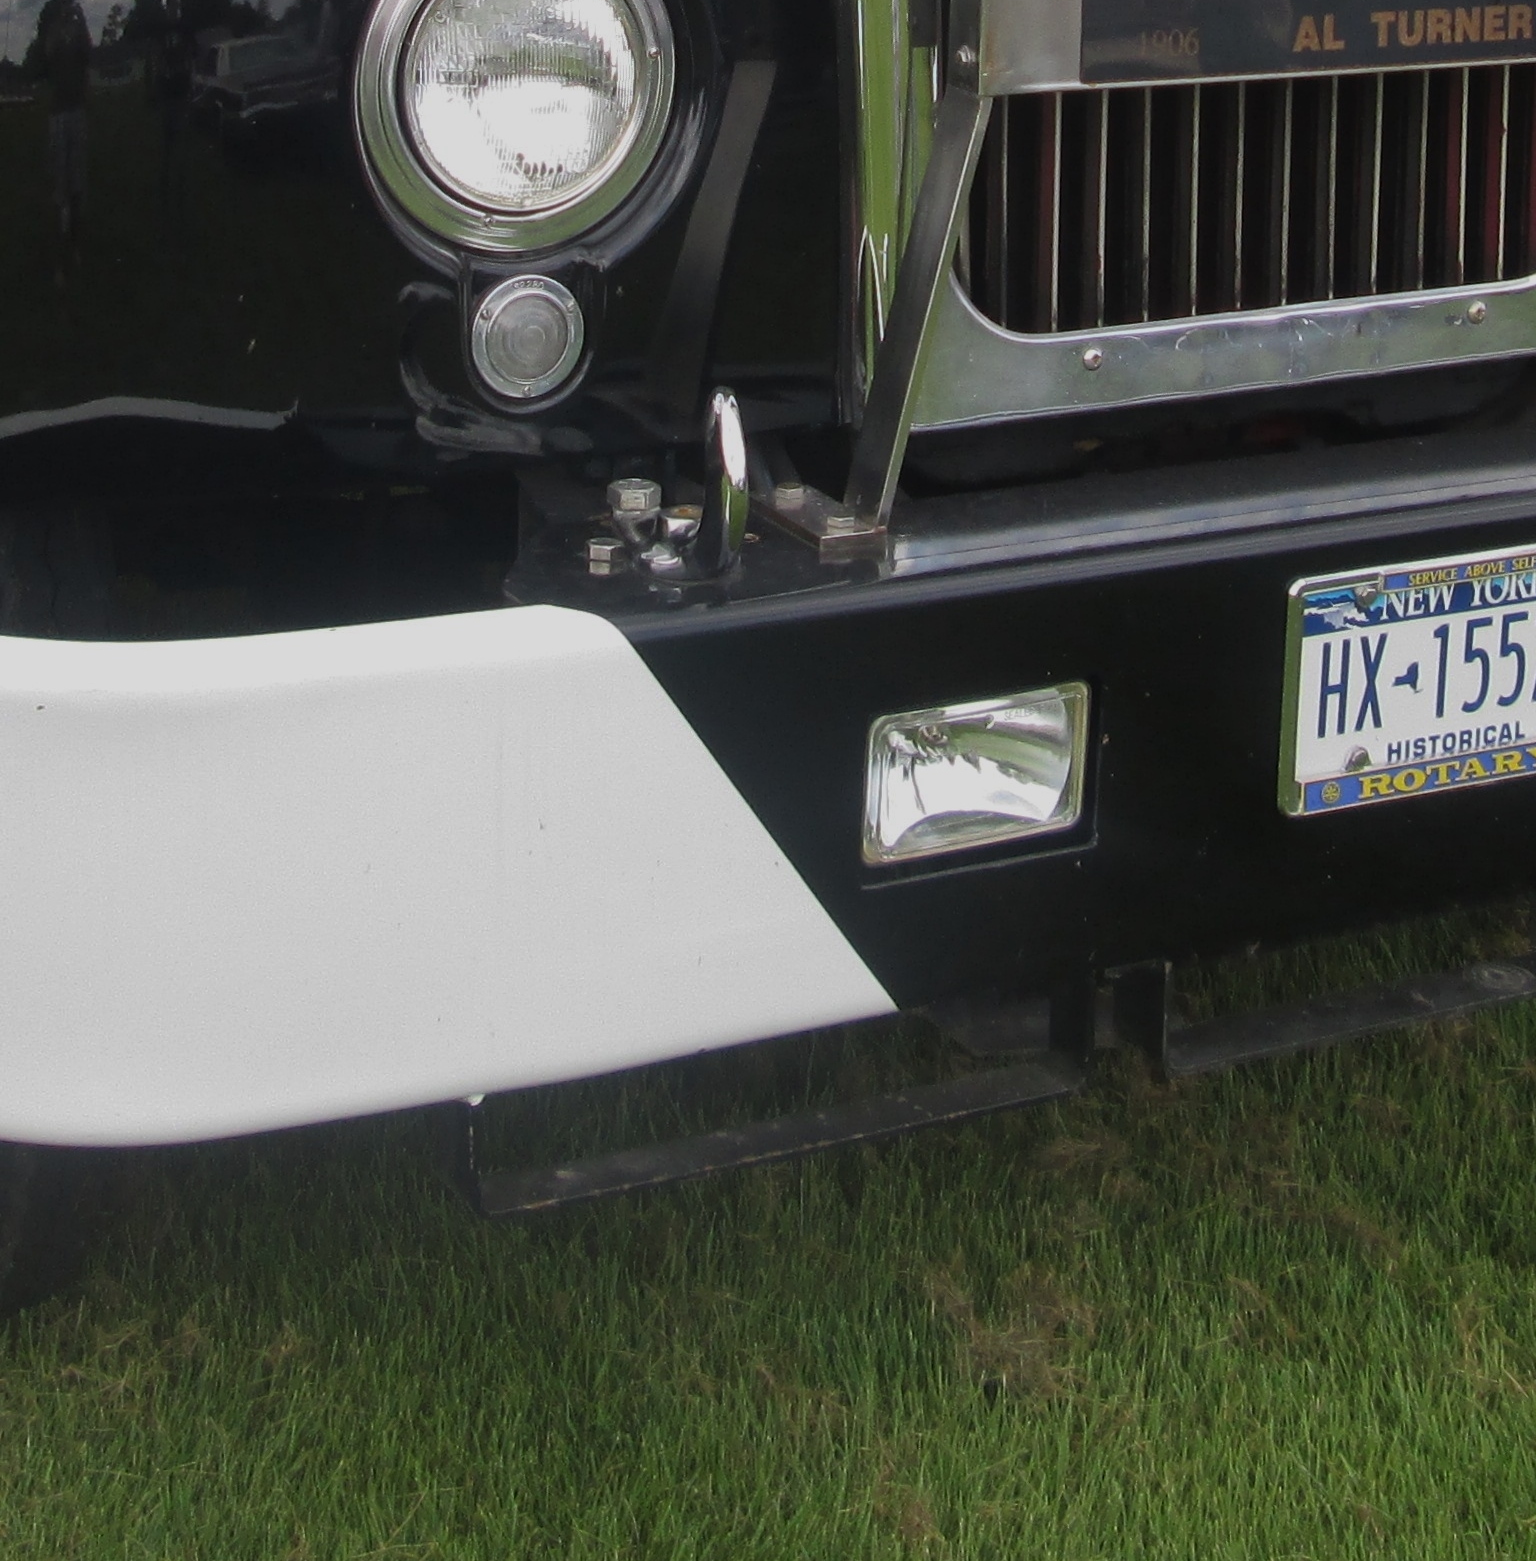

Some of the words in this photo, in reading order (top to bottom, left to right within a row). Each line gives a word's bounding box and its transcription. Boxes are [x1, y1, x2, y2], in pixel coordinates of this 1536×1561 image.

[1292, 18, 1346, 53] AL
[1370, 4, 1533, 47] TURNER
[1408, 566, 1458, 587] SERVICE
[1464, 560, 1507, 579] ABOVE
[1380, 584, 1456, 621] NEW
[1317, 633, 1388, 739] HX
[1387, 720, 1526, 765] HISTORICAL
